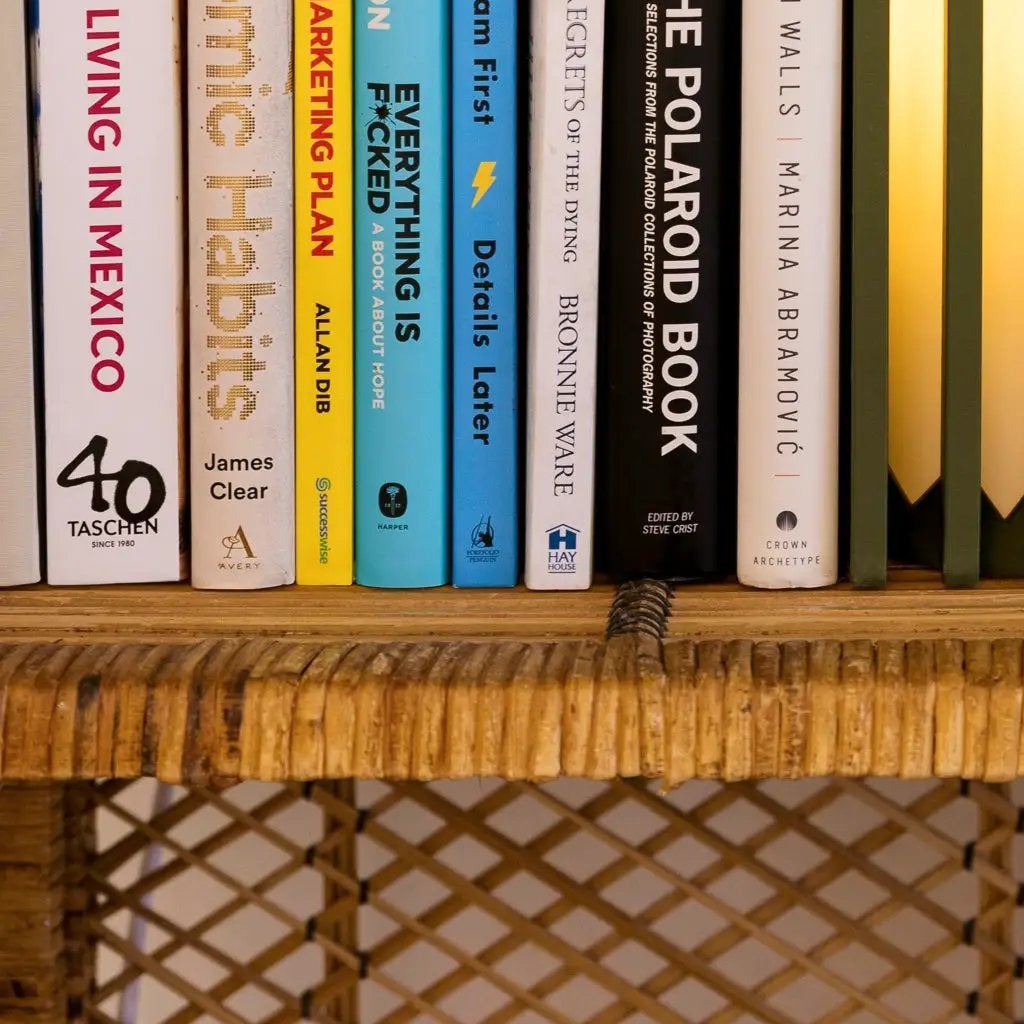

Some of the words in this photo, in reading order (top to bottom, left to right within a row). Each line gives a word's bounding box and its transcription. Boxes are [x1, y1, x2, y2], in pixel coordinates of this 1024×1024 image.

[646, 2, 659, 78] SELECTIONS
[779, 21, 802, 116] WALLS
[86, 9, 122, 152] LIVING
[473, 58, 499, 125] First
[646, 81, 657, 118] FROM
[566, 118, 582, 144] OF
[645, 121, 657, 146] THE
[88, 165, 123, 209] IN
[394, 82, 421, 301] EVERYTHING
[565, 150, 582, 193] THE
[644, 148, 657, 210] POLAROID
[661, 68, 703, 305] POLAROID
[311, 172, 335, 257] PLAN
[371, 222, 385, 235] A
[564, 200, 580, 264] DYING
[778, 162, 801, 272] MARINA
[370, 240, 385, 294] BOOK
[643, 213, 657, 298] COLLECTIONS
[90, 224, 126, 393] MEXICO
[205, 174, 276, 421] Habits
[472, 239, 499, 348] Details
[642, 301, 655, 319] OF
[315, 302, 332, 373] ALLAN
[371, 298, 385, 357] ABOUT
[394, 312, 421, 343] IS
[557, 294, 579, 414] BRONNIE
[315, 378, 331, 415] DIB
[371, 362, 385, 410] HOPE
[642, 321, 655, 414] PHOTOGRAPHY
[660, 322, 700, 457] BOOK
[776, 288, 804, 455] ABRAMOVIĆ
[472, 366, 497, 446] Later
[56, 435, 167, 523] 40
[204, 453, 275, 472] James
[553, 420, 576, 497] WARE
[209, 483, 269, 501] Clear
[647, 513, 680, 523] EDITED
[682, 512, 694, 522] BY
[67, 518, 159, 538] TASCHEN
[91, 540, 115, 549] SINCE
[117, 539, 136, 549] 1980
[319, 492, 332, 565] successwise
[548, 551, 577, 563] HAY
[642, 524, 670, 535] STEVE
[672, 523, 698, 534] CRIST
[766, 540, 808, 550] CROWN
[218, 561, 261, 571] AVERY
[547, 563, 576, 571] HOUSE
[753, 555, 821, 566] ARCHETYPE
